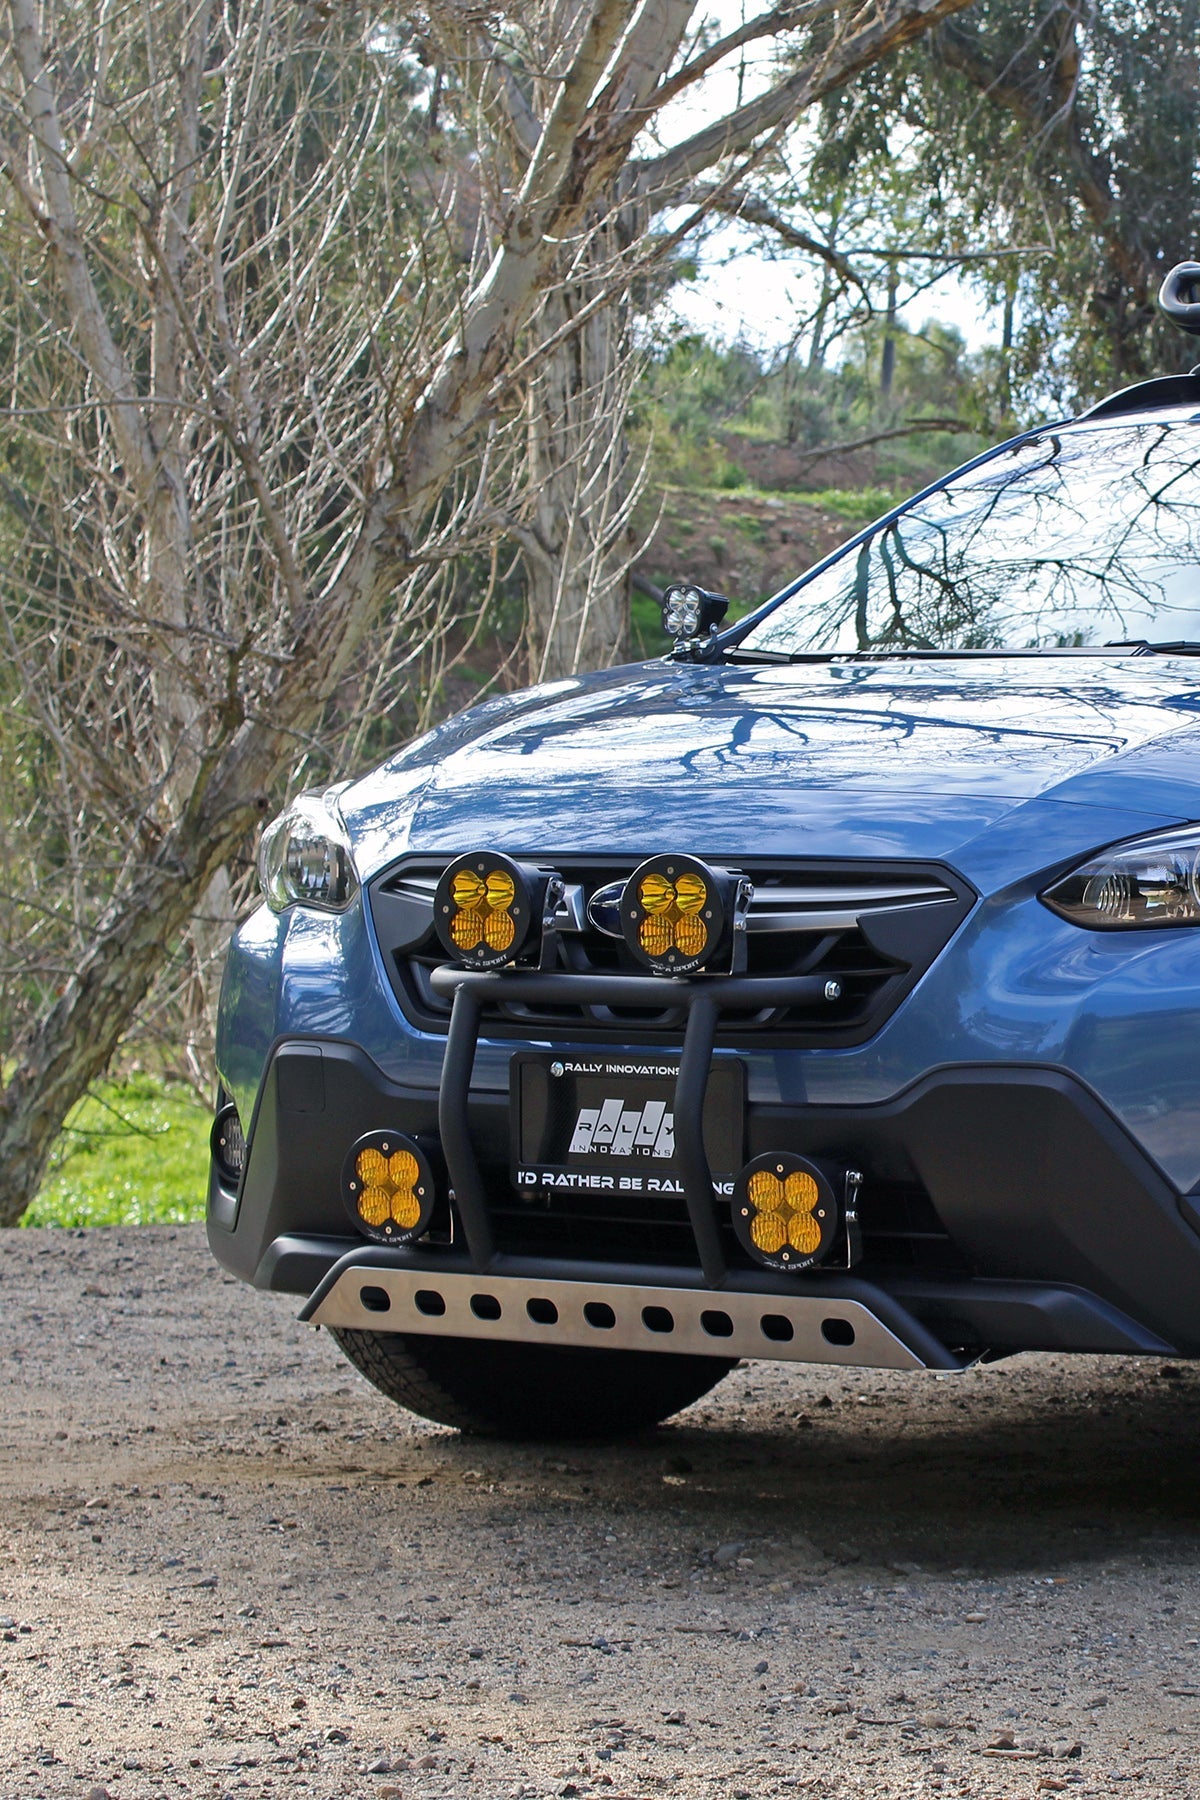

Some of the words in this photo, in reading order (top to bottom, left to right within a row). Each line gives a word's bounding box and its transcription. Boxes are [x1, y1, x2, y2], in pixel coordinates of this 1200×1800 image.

[673, 959, 699, 972] SPORT
[565, 1062, 603, 1072] RALLY
[578, 1123, 674, 1136] RALLY
[572, 1144, 671, 1156] INNOVATIONS
[517, 1171, 537, 1184] I'D
[541, 1173, 614, 1189] RATHER
[619, 1177, 643, 1191] BE
[647, 1179, 735, 1195] RALNG
